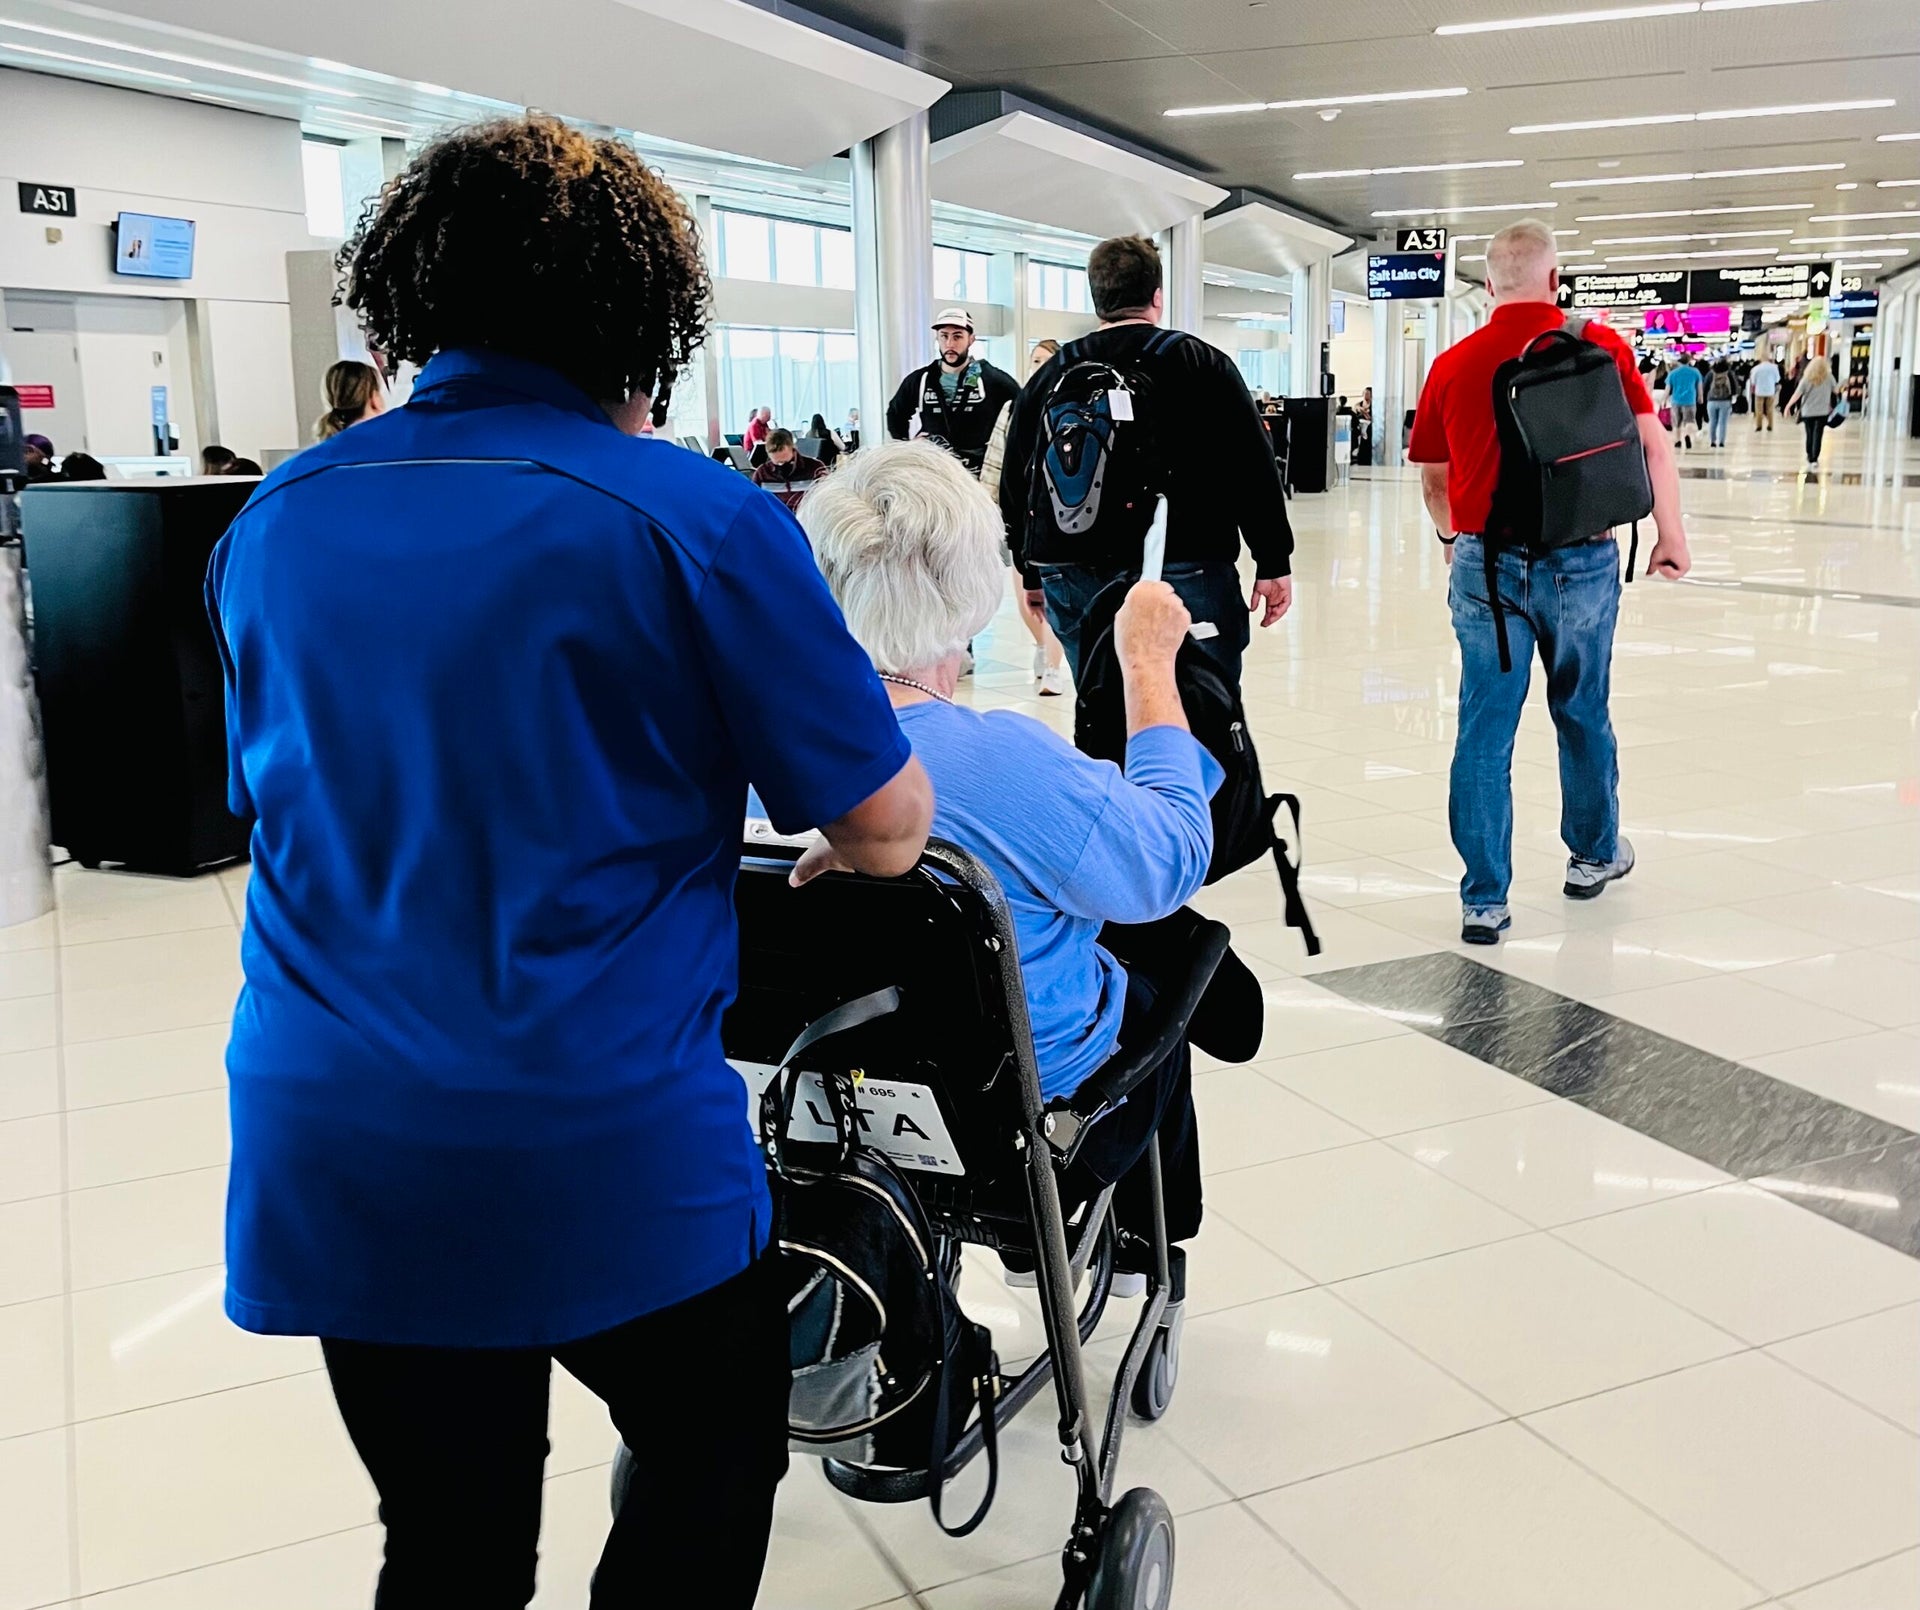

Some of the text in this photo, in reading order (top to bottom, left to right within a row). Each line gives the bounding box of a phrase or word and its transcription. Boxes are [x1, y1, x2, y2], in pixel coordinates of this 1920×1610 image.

[33, 188, 69, 212] A31
[1403, 229, 1446, 251] A31
[1369, 267, 1441, 282] Salt Lake City
[868, 1087, 897, 1099] 695
